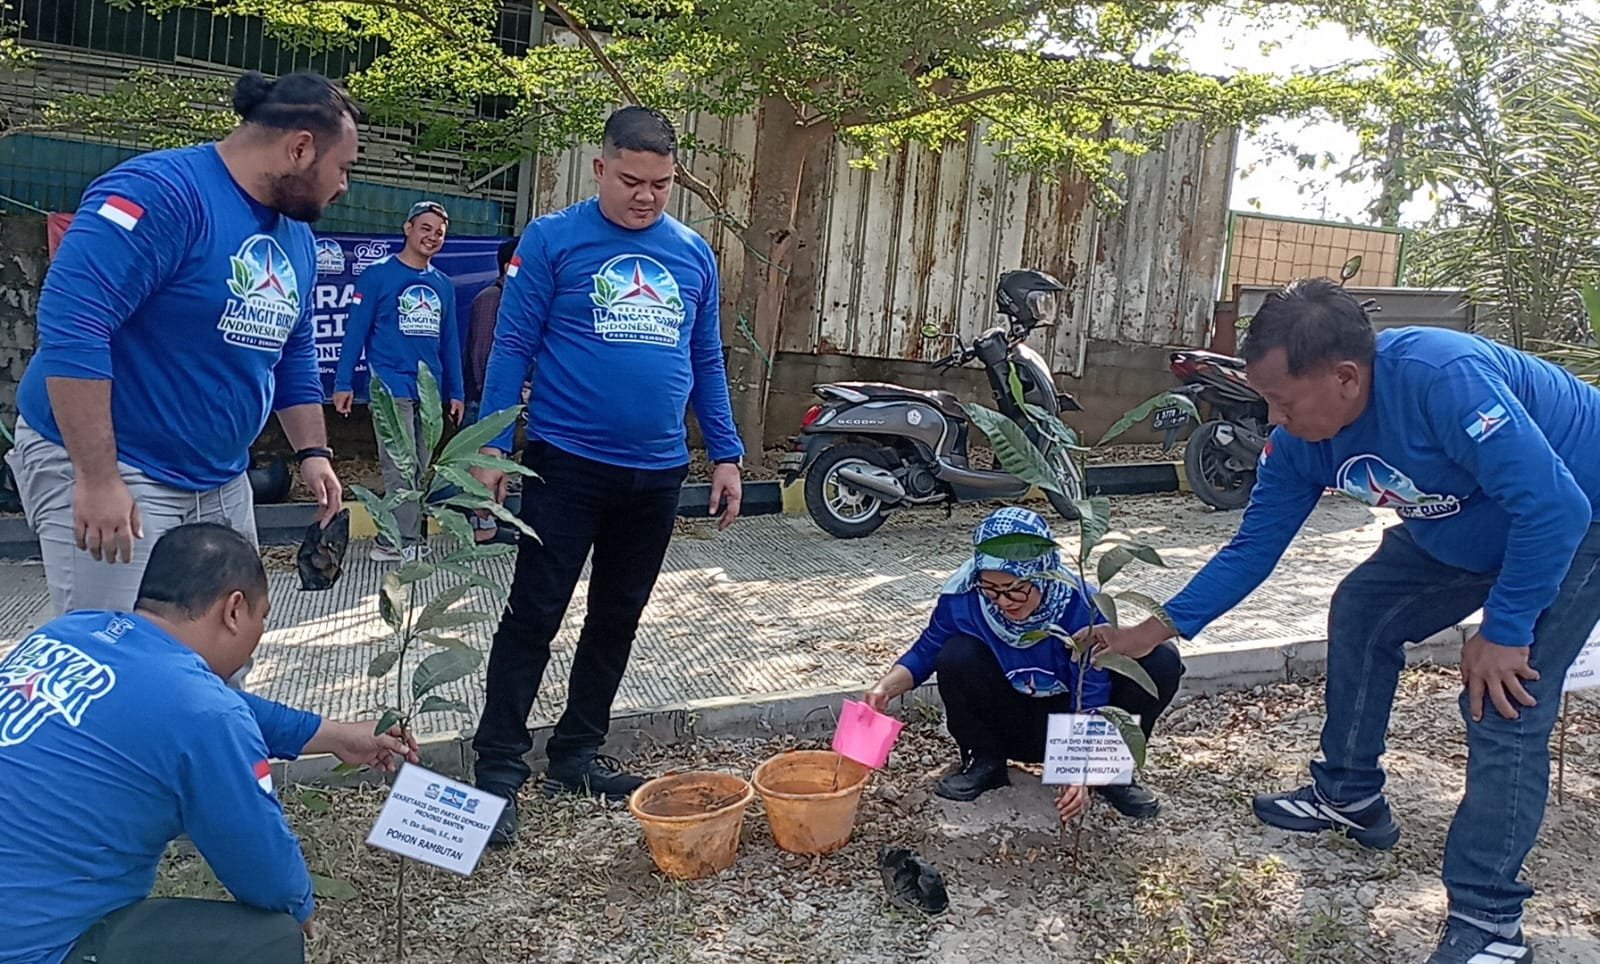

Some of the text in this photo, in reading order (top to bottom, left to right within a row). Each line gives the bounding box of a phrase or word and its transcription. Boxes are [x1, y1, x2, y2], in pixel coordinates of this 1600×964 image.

[225, 301, 275, 325] LANGIT
[400, 316, 429, 324] LANGIT
[595, 309, 651, 323] LANGIT
[220, 318, 275, 338] INDONESIA
[596, 323, 660, 333] INDONESIA
[231, 334, 257, 345] PARTAI
[392, 792, 427, 809] SEKRETARIS
[440, 809, 461, 821] PARTAI
[461, 816, 491, 832] DEMOKRAT
[414, 809, 465, 832] PROVINSI BANTEN
[386, 827, 464, 861] POHON RAMBUTAN
